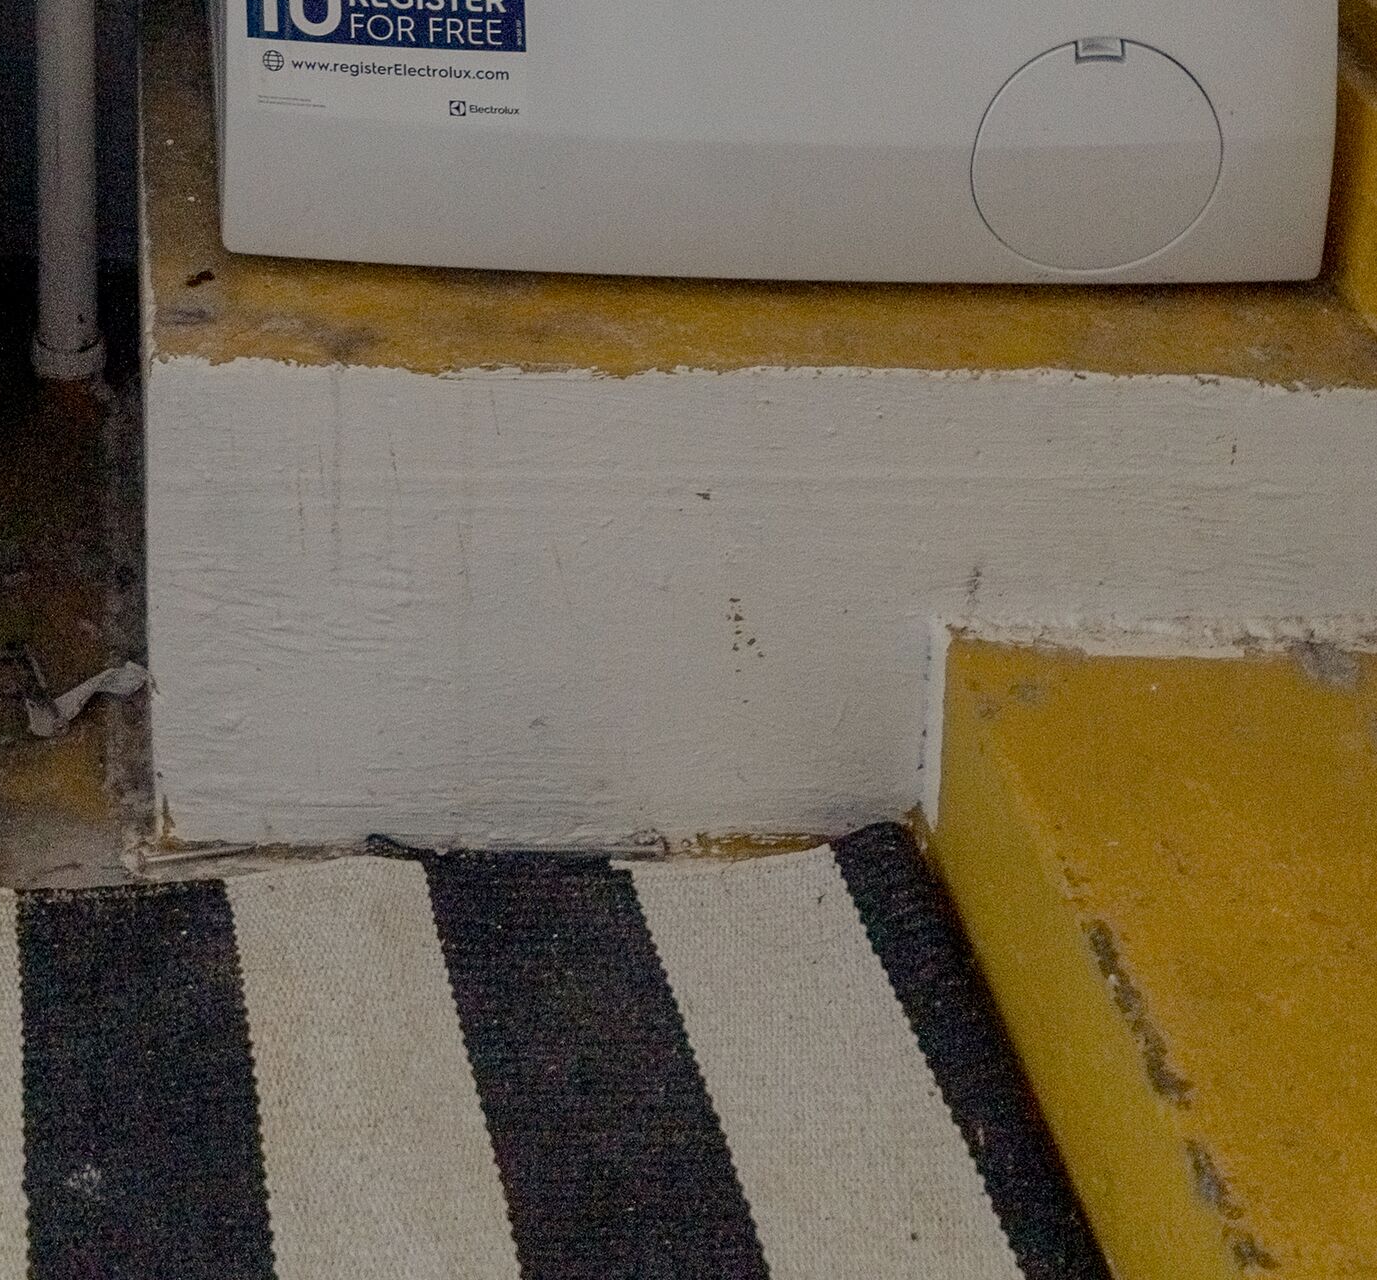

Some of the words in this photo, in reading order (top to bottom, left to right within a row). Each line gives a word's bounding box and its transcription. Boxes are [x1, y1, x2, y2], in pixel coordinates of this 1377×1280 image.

[350, 13, 416, 42] FOR
[429, 17, 503, 45] FREE
[291, 59, 510, 81] www.registerElectrolux.com
[469, 104, 520, 116] Electrolux
